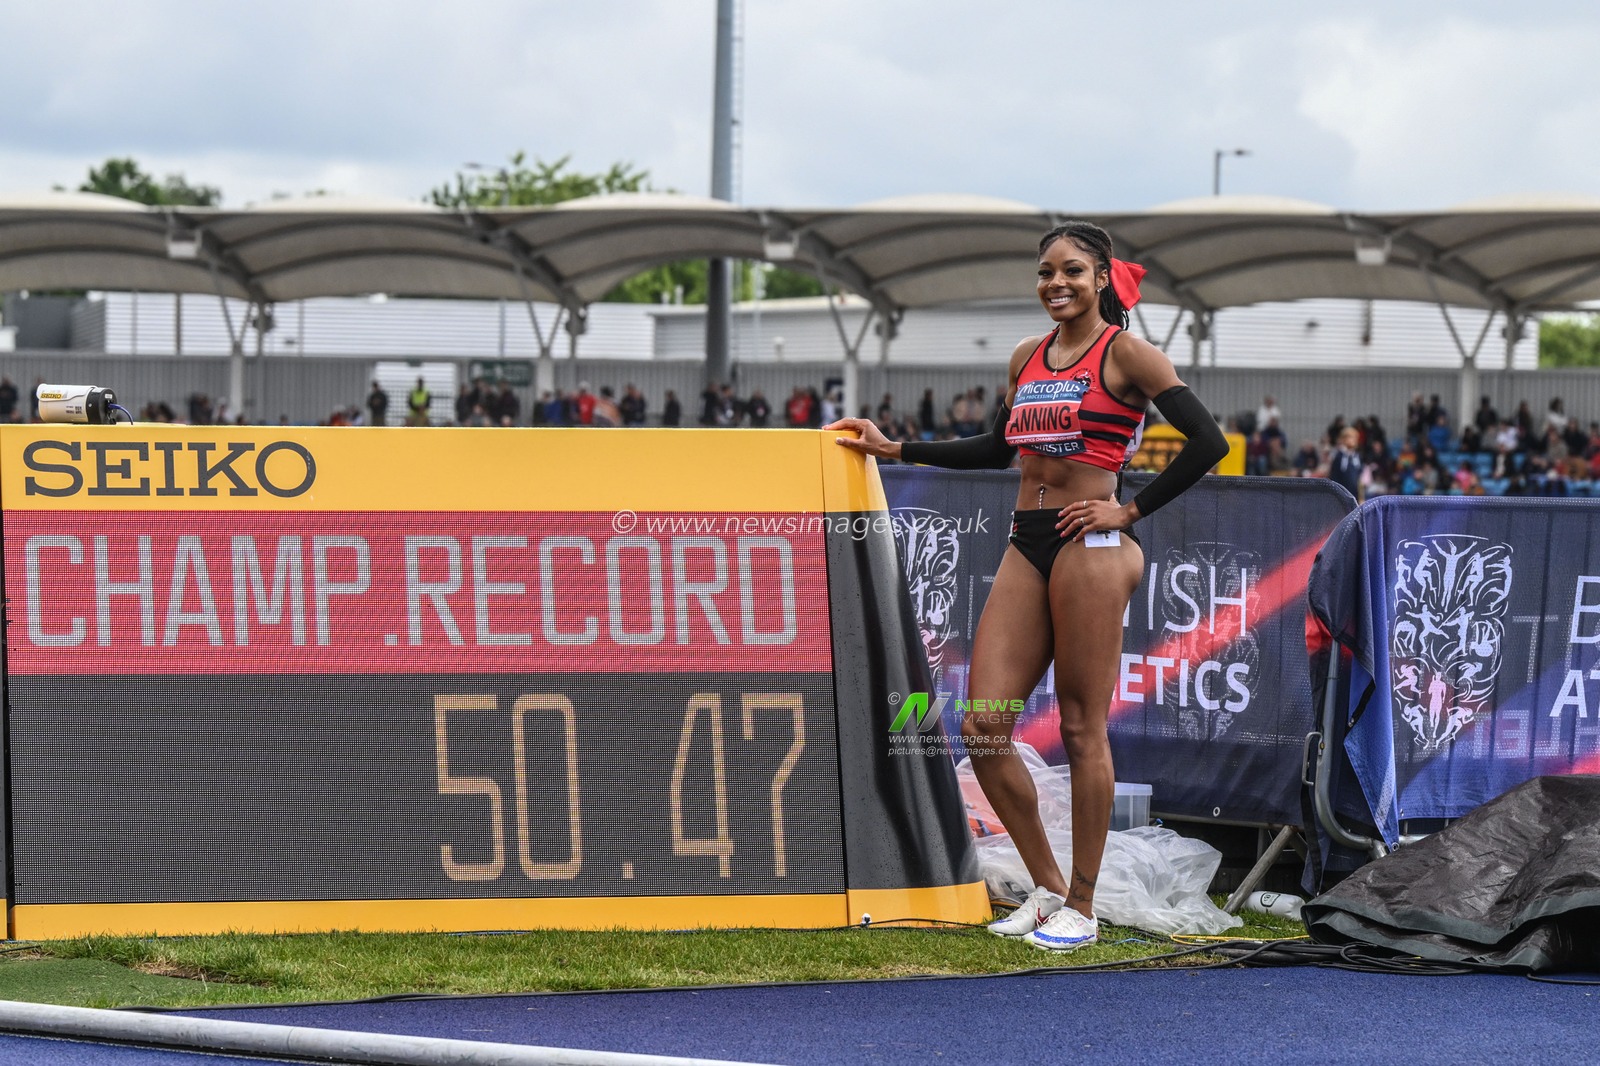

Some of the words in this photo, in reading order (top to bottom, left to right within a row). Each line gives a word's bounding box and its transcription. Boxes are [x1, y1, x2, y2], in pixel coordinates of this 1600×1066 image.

[1018, 380, 1081, 400] Microplus
[1009, 405, 1072, 433] ANNING
[23, 439, 318, 498] SEIKO
[433, 692, 806, 881] 50.47
